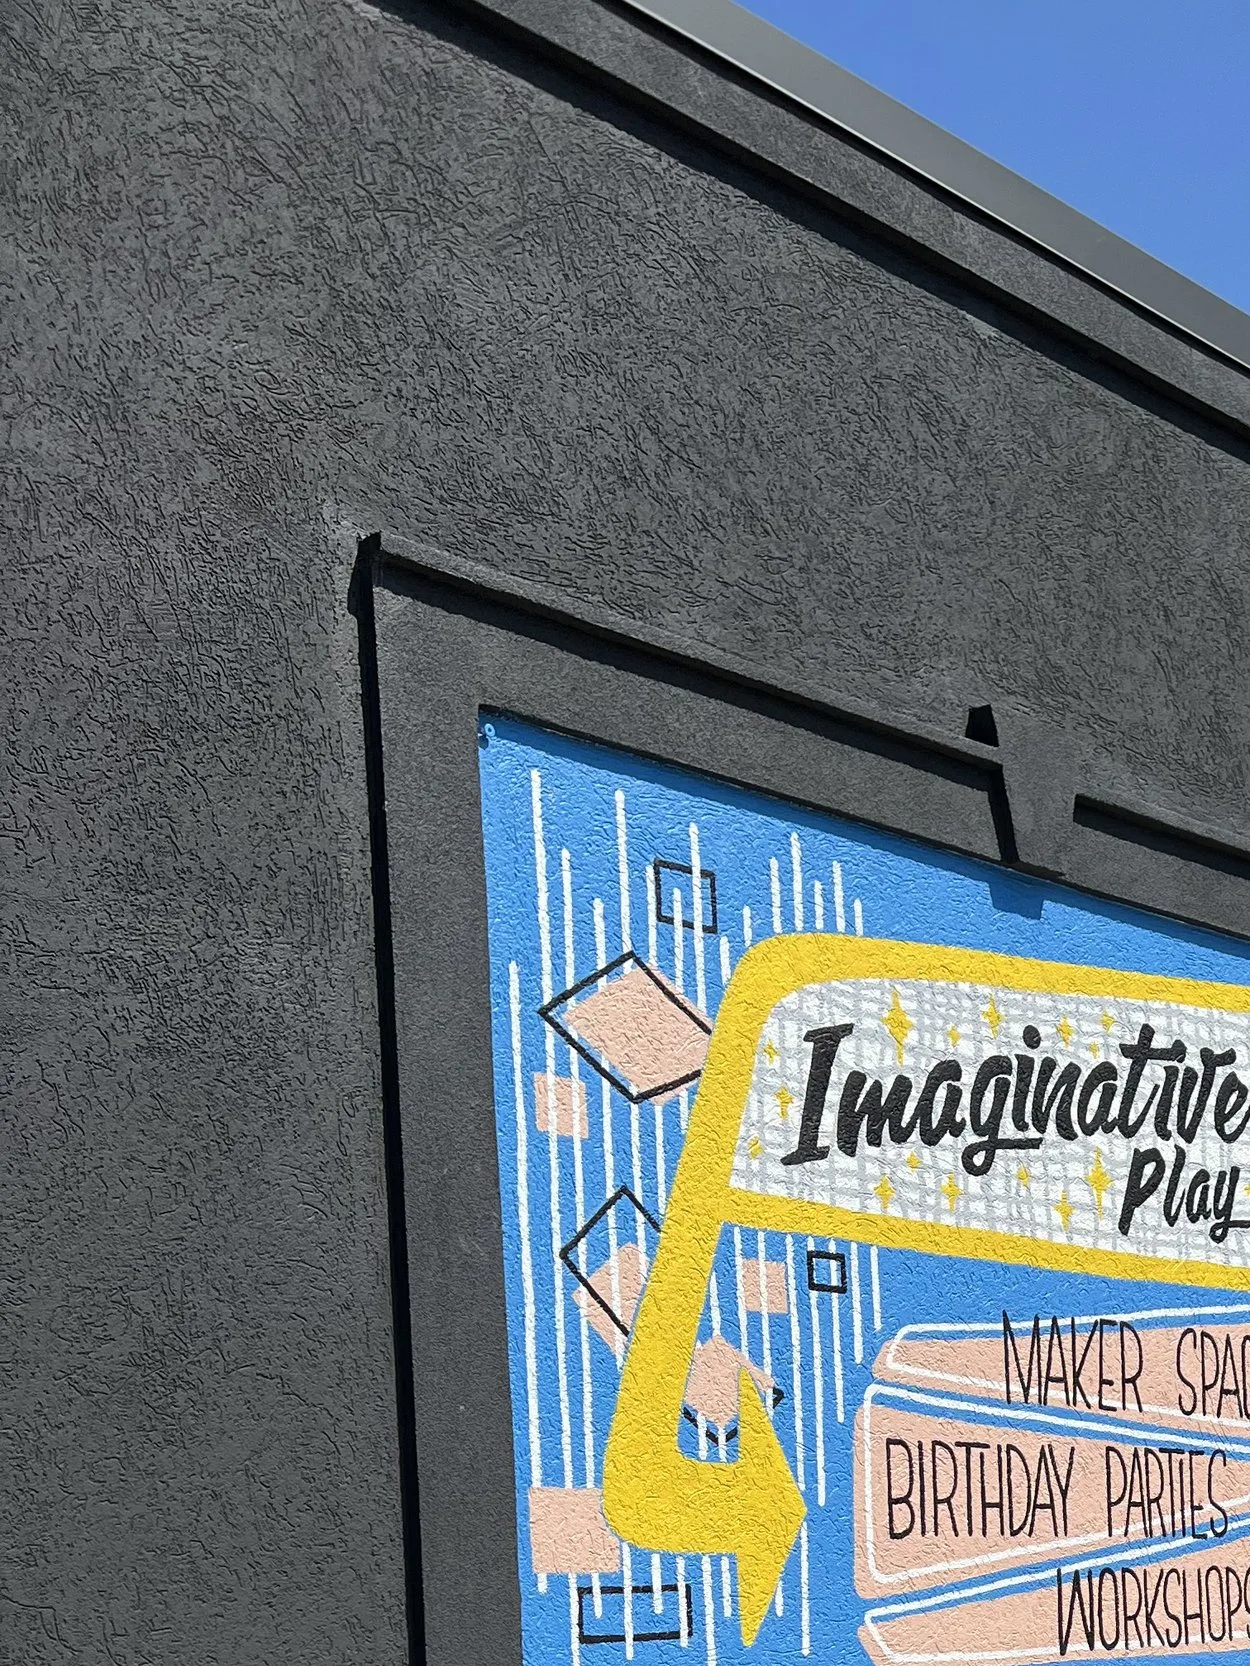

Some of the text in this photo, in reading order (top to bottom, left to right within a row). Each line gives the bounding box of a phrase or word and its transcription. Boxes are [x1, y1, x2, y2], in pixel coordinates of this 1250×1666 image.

[1002, 1310, 1143, 1412] MAKER
[885, 1438, 1228, 1541] BIRTHDAY PARTIES
